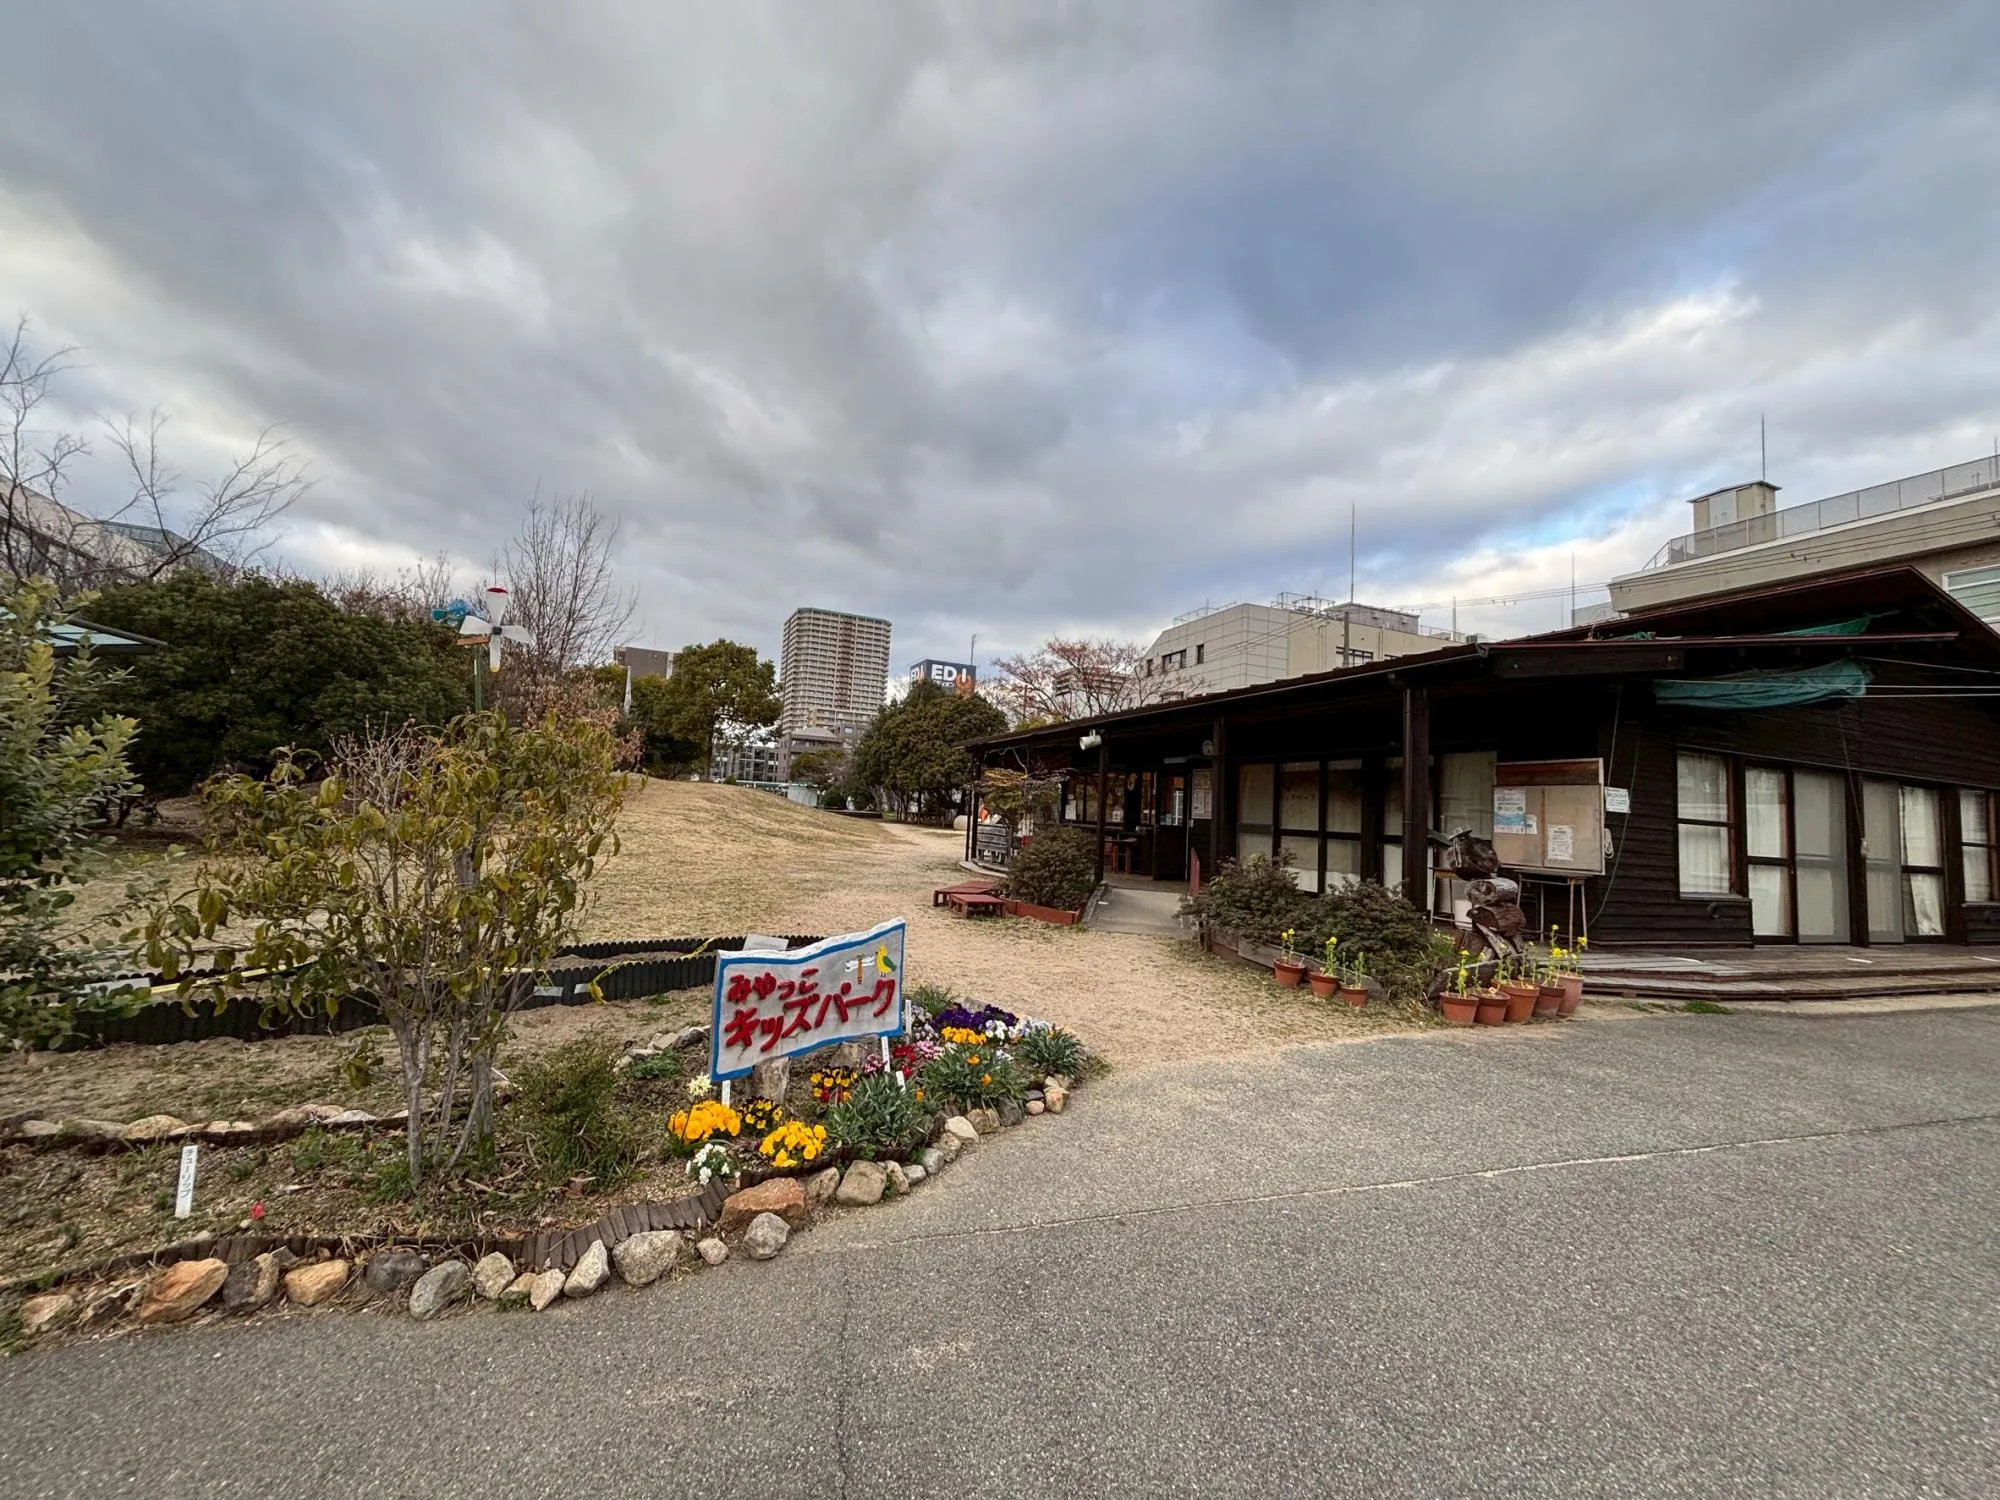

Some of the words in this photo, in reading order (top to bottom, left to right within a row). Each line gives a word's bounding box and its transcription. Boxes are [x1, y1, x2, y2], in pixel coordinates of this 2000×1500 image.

[727, 968, 819, 1003] みやっこ
[725, 979, 896, 1051] キッズパーク
